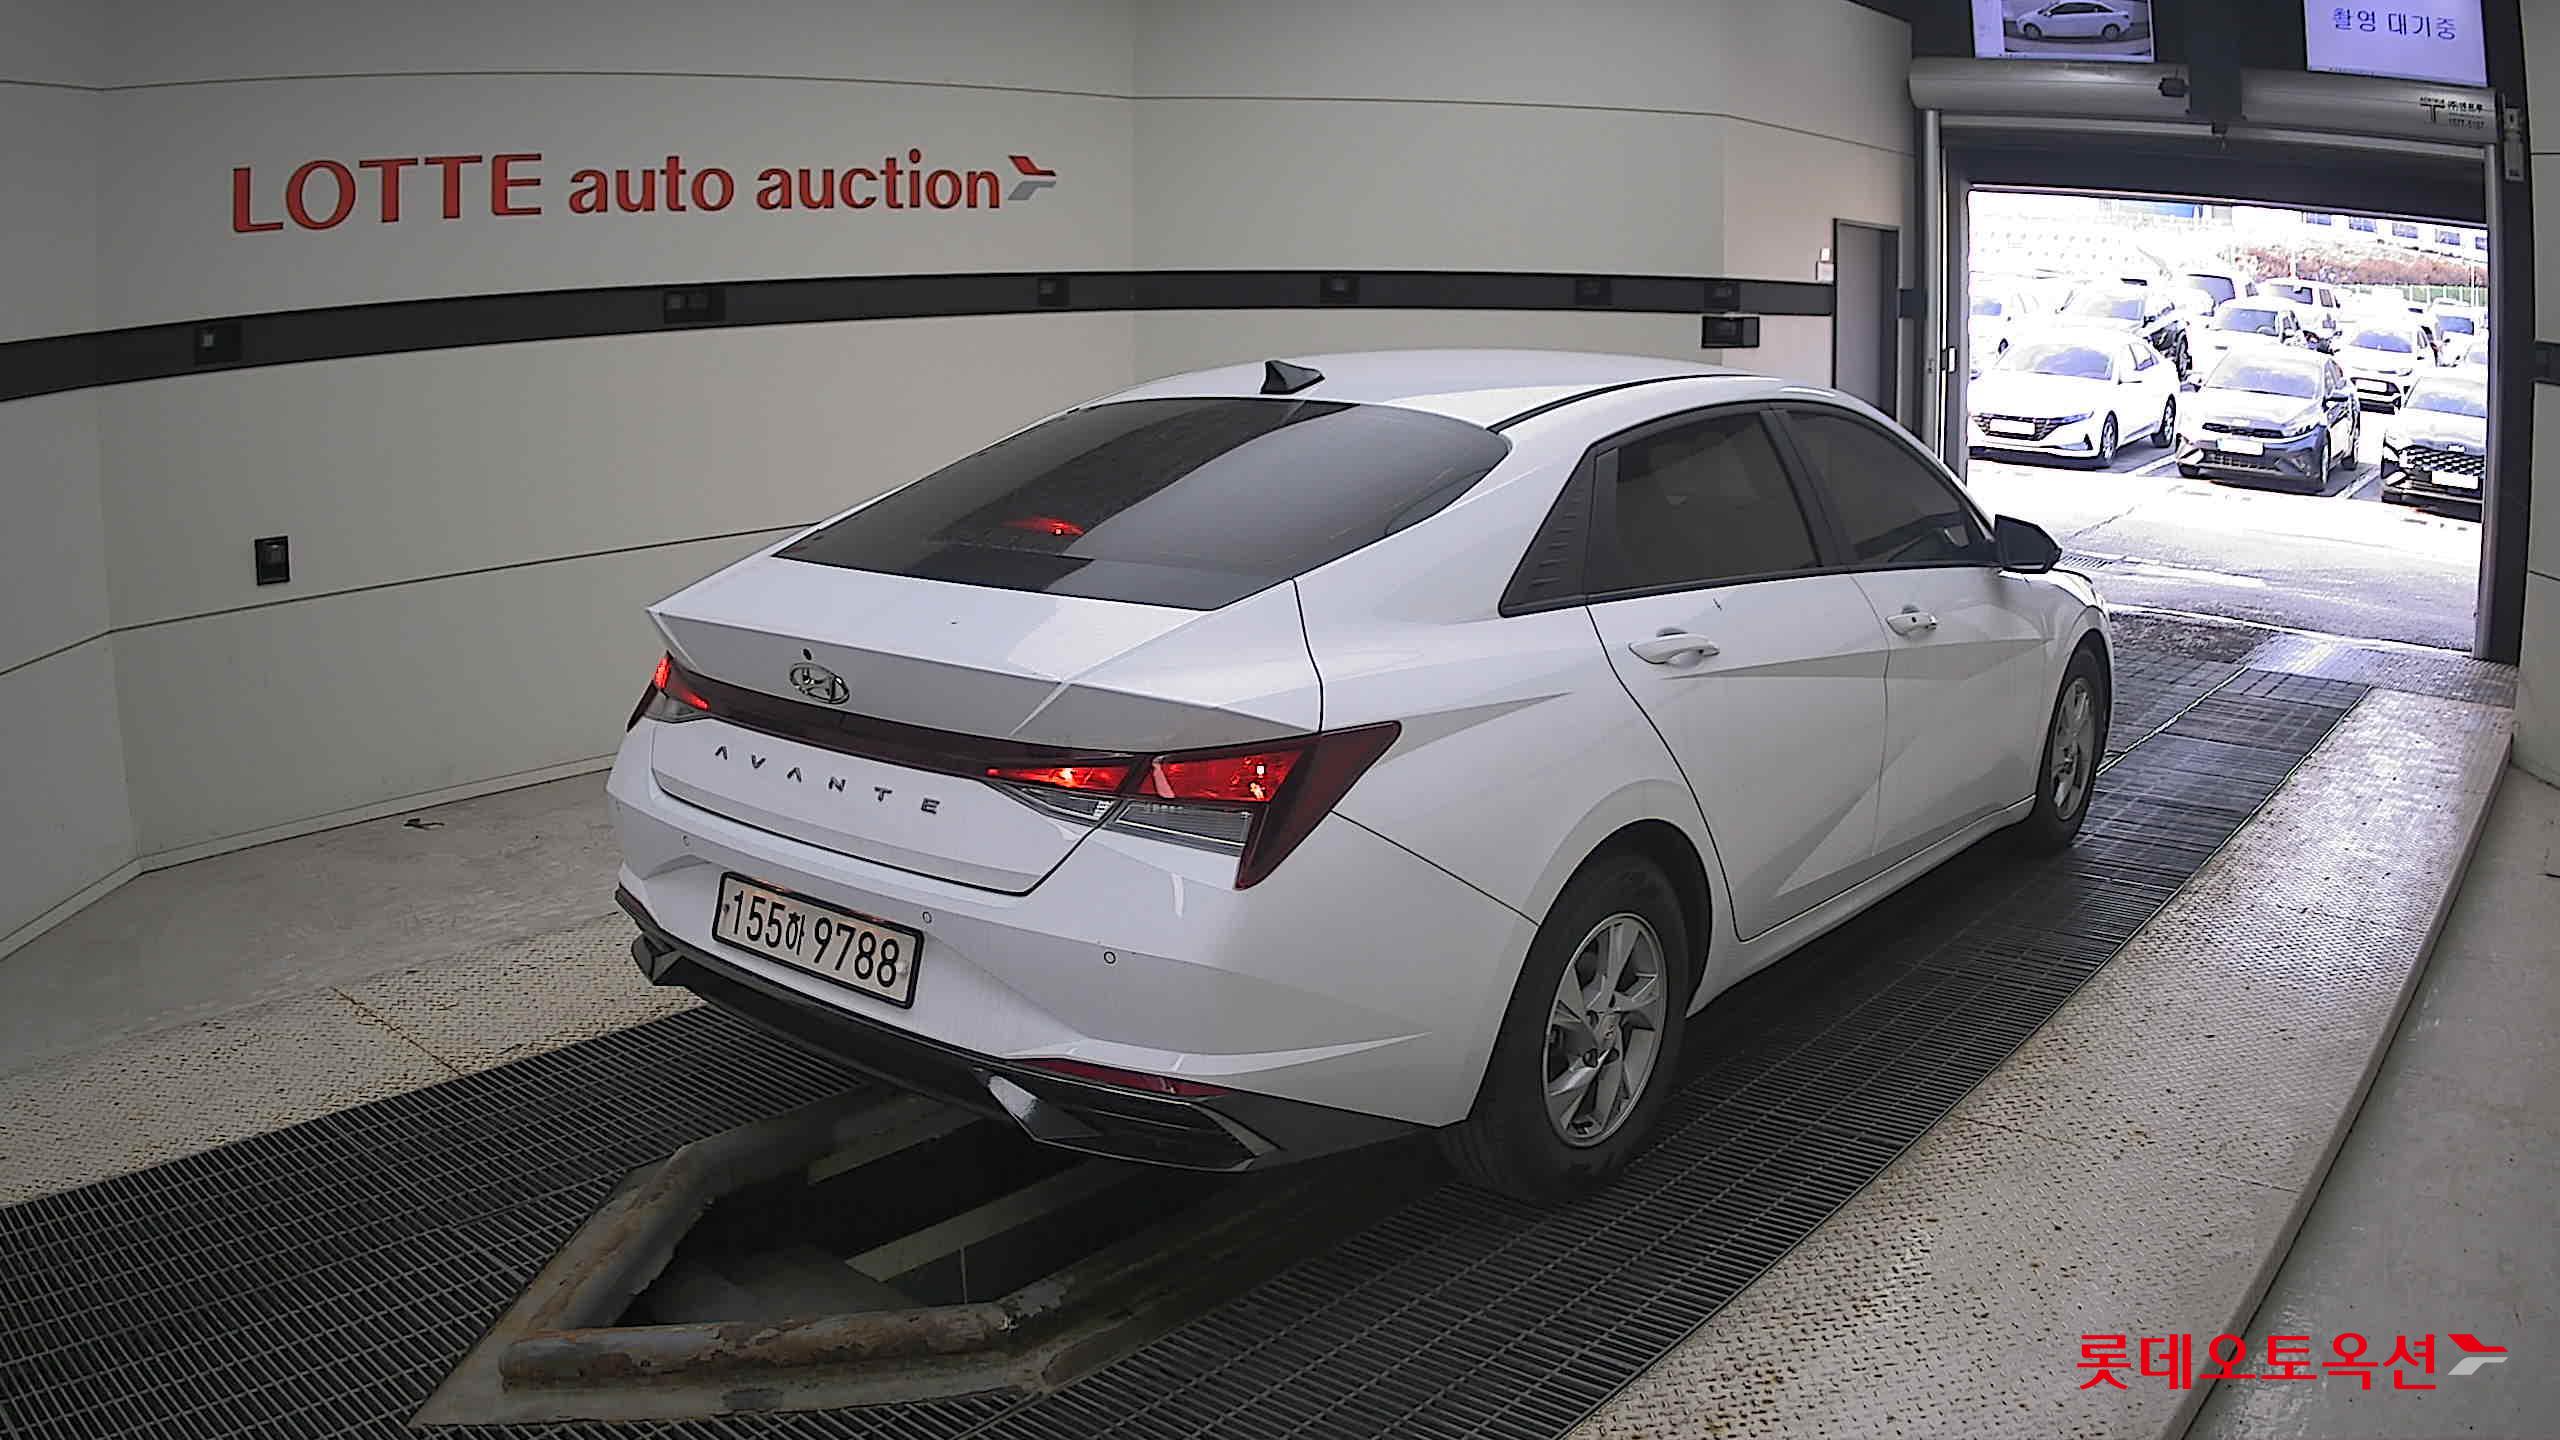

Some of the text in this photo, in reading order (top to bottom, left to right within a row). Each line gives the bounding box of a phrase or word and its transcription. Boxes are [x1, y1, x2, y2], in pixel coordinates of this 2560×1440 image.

[2332, 7, 2457, 41] 촬영 대기중
[231, 150, 1003, 234] LOTTE auto auction
[714, 744, 941, 815] AVANTE
